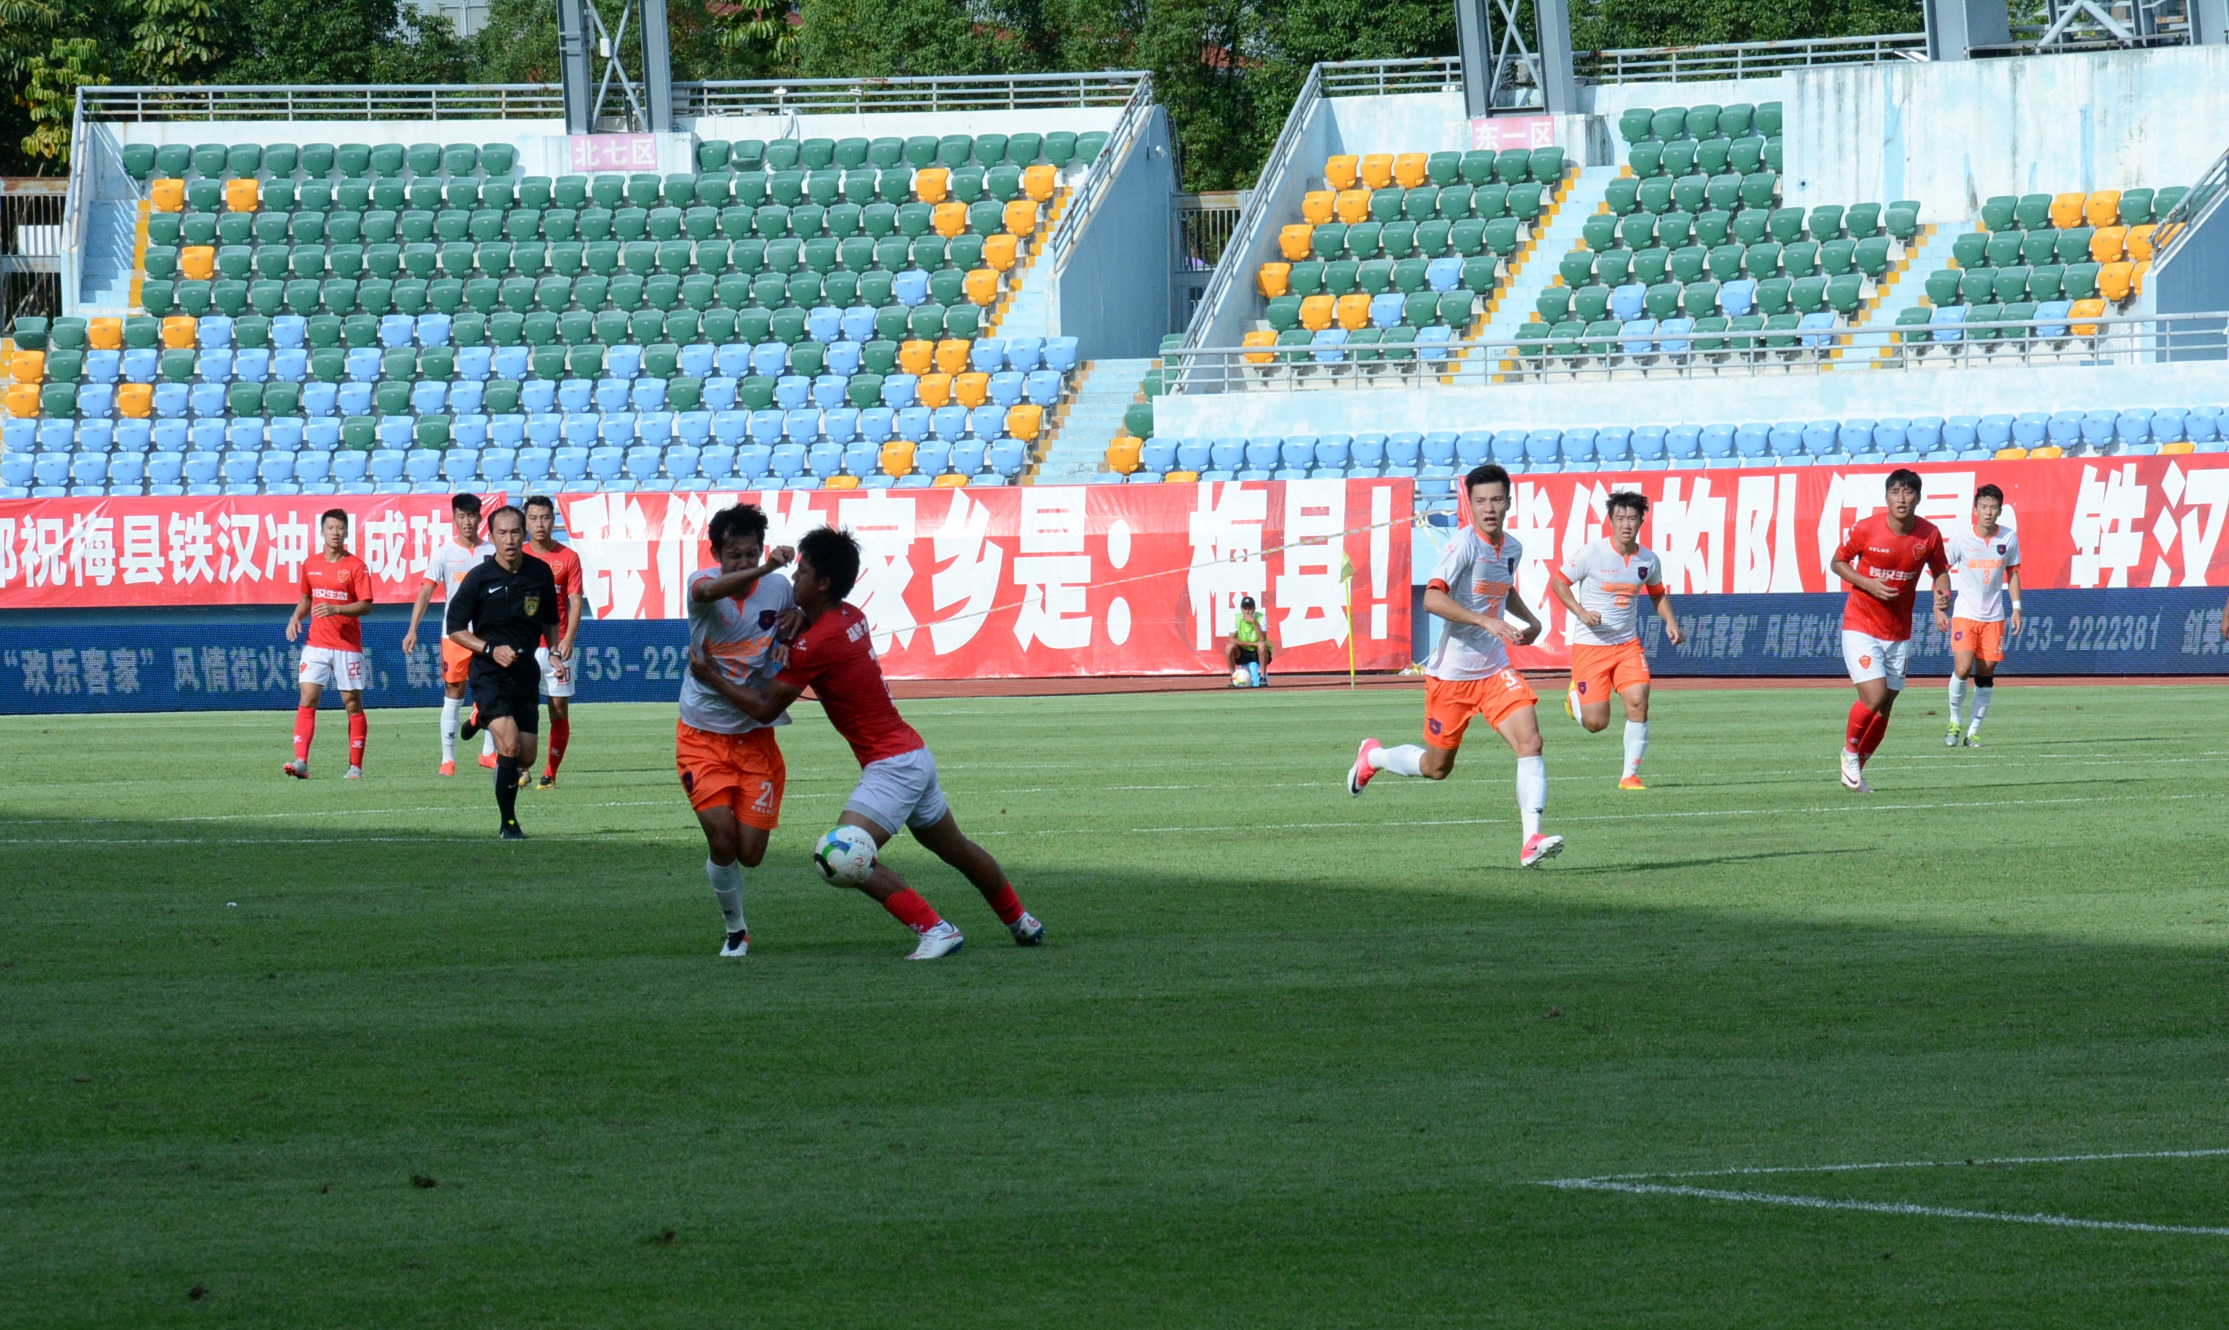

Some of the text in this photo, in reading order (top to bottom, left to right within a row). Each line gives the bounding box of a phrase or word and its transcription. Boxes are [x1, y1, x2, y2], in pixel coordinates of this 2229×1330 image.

[1475, 121, 1553, 150] 东一区
[574, 139, 656, 167] 北七区
[1868, 546, 1891, 554] KELME
[1982, 569, 1991, 585] 3
[349, 661, 362, 677] 22
